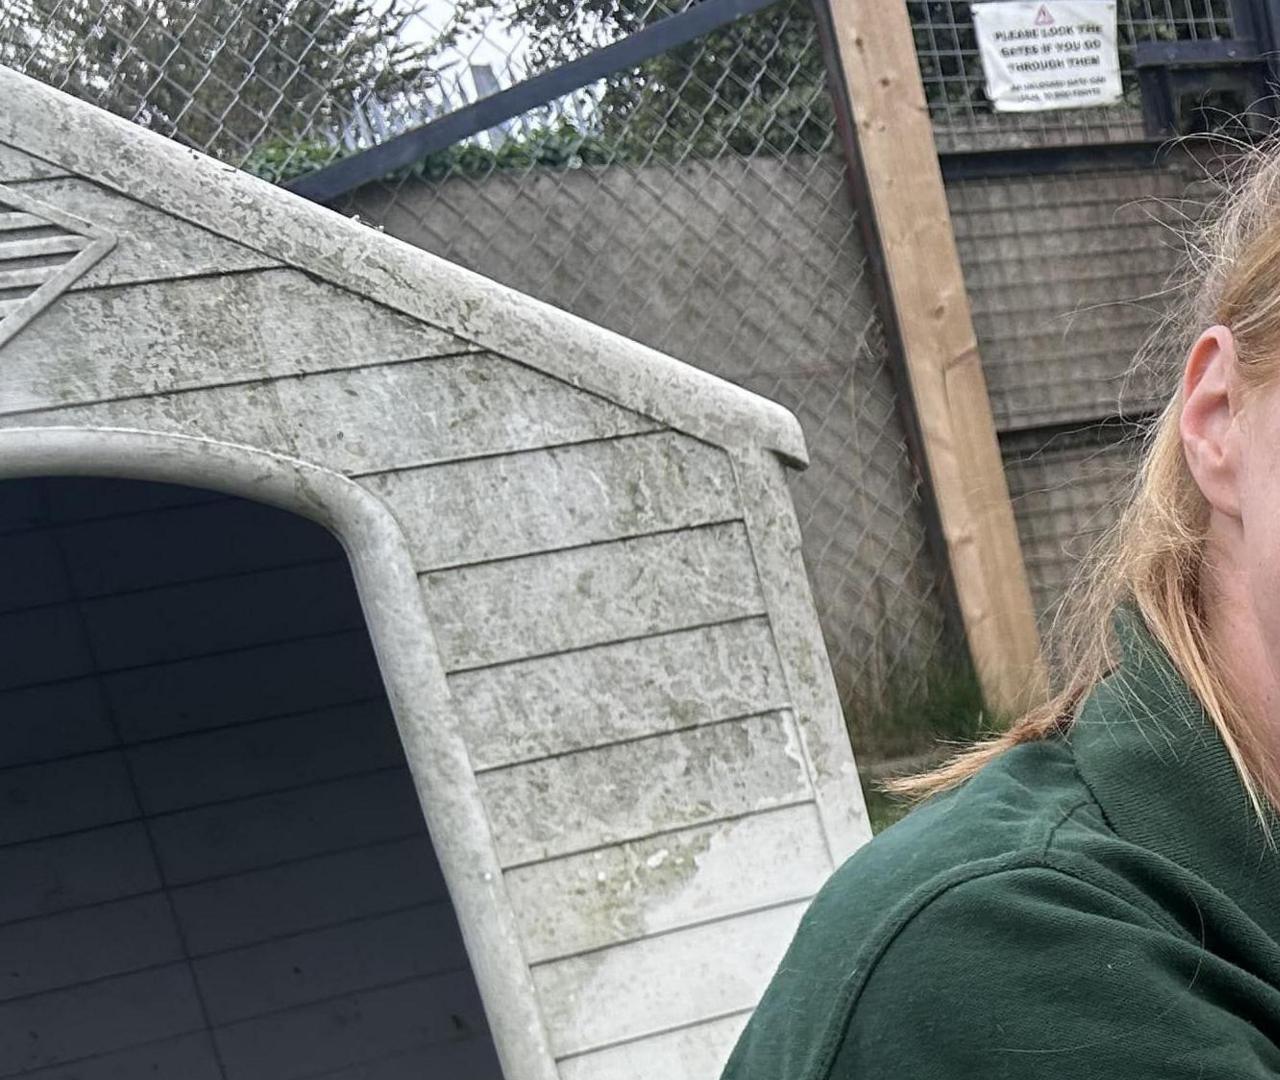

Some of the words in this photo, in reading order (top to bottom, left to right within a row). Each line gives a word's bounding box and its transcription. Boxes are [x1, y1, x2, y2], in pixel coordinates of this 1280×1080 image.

[1077, 24, 1103, 34] THE
[1055, 41, 1081, 52] YOU
[1007, 60, 1065, 72] THROUGH
